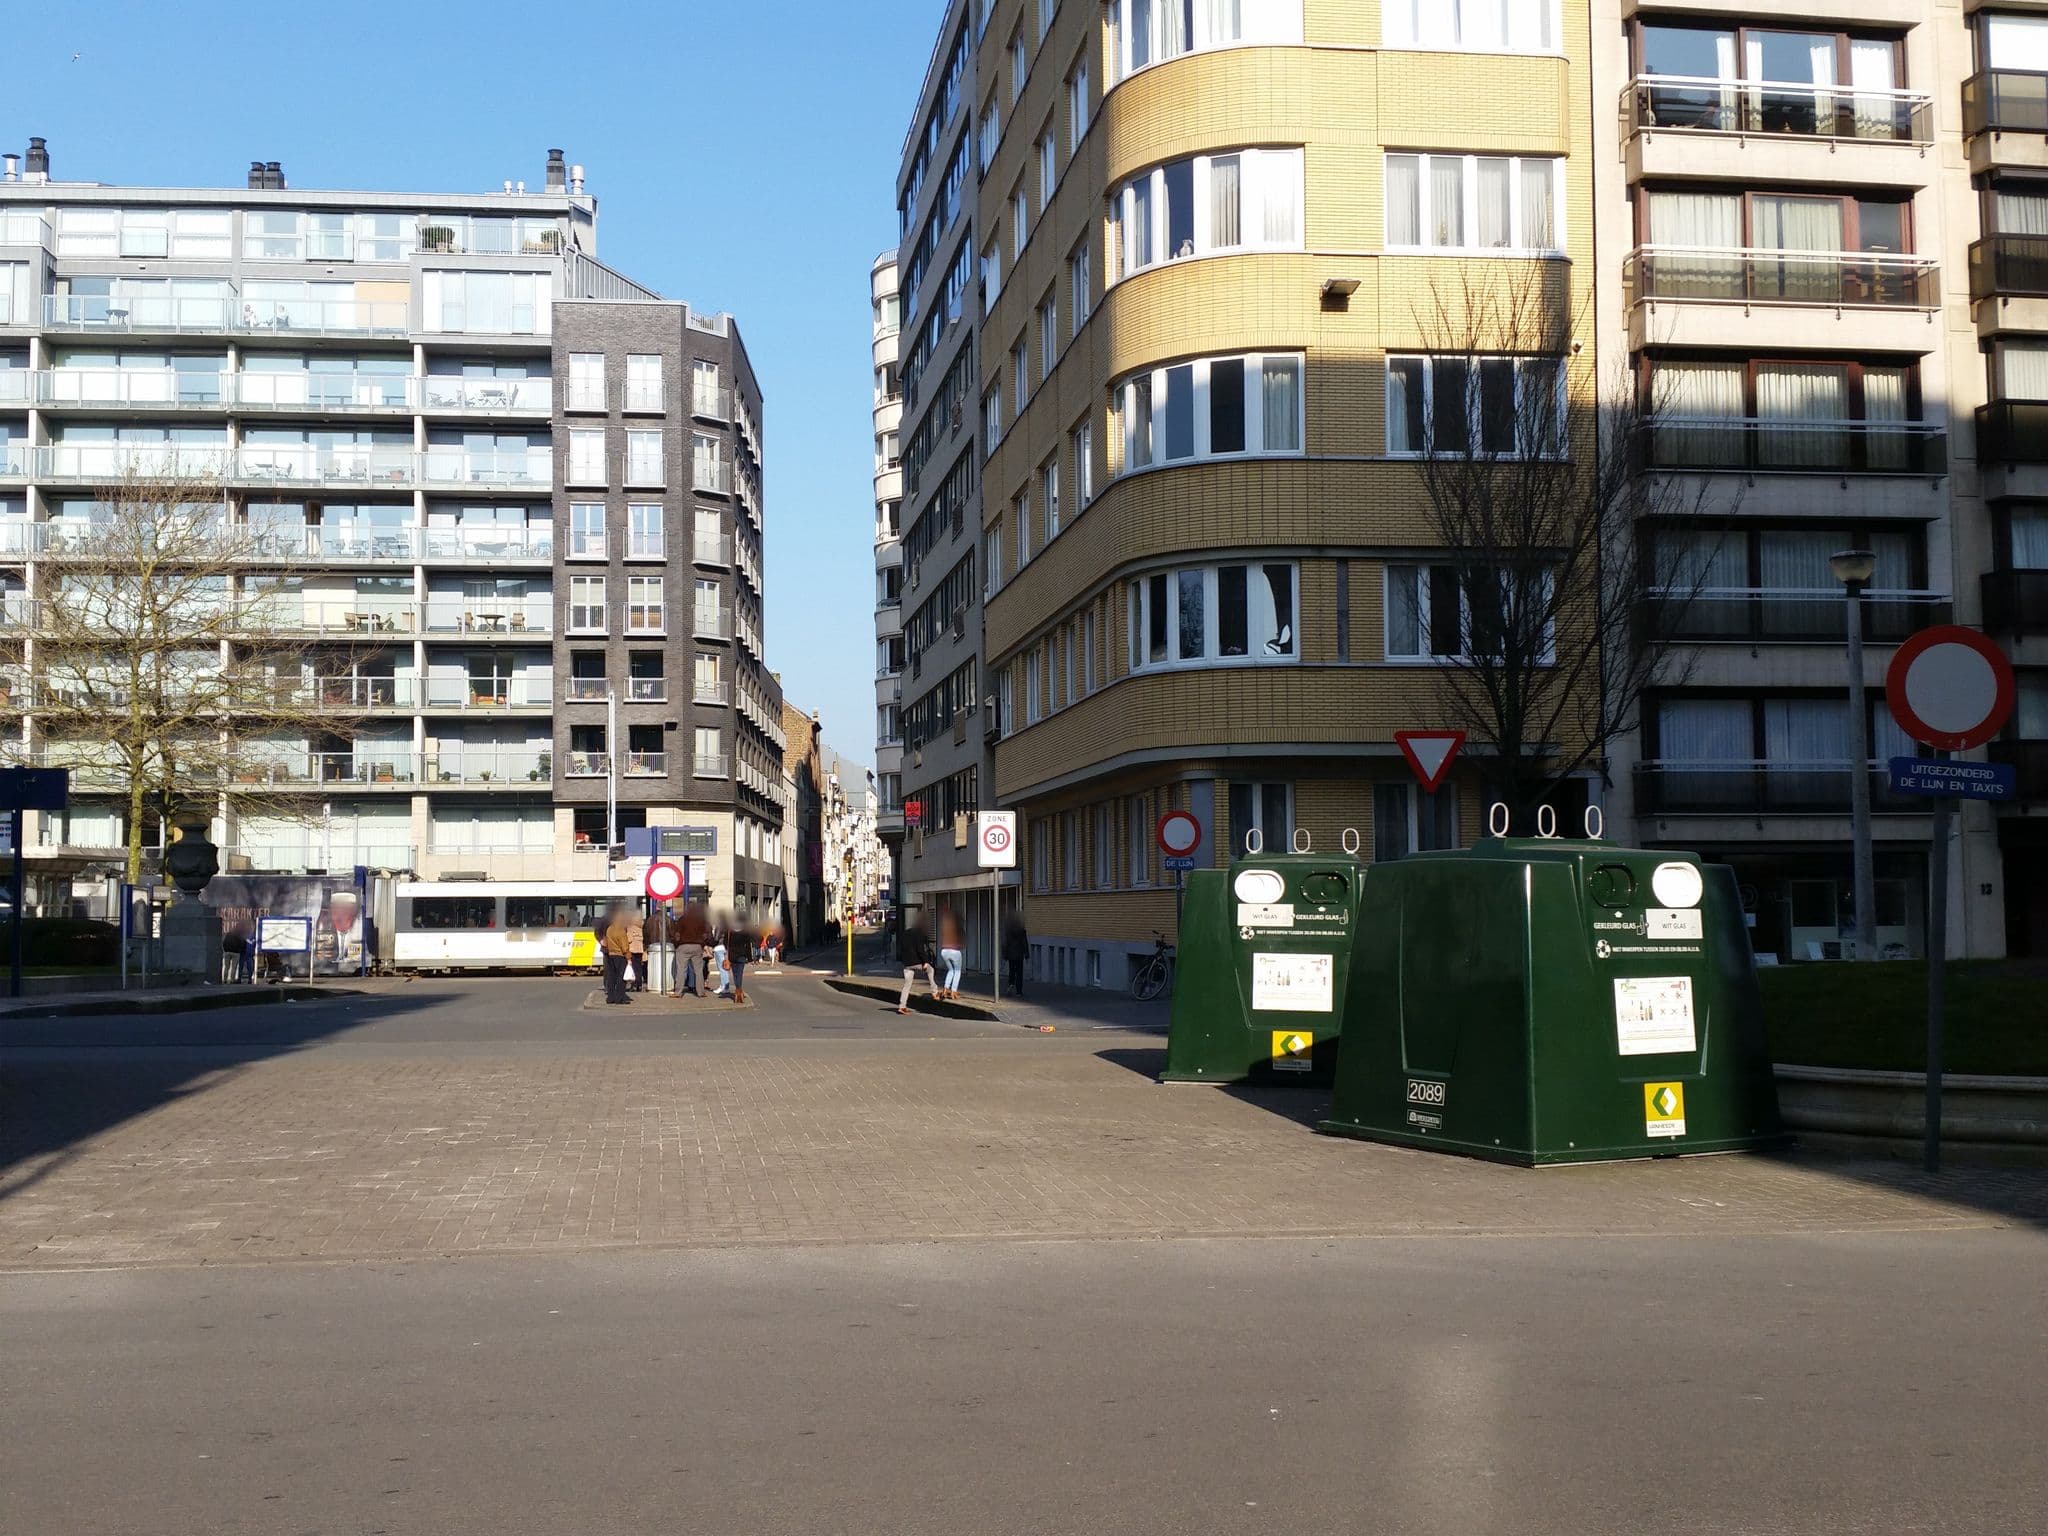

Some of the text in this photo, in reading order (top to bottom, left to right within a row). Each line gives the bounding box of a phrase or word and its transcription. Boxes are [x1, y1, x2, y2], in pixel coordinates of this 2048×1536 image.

[1911, 764, 1994, 780] UITGEZONDERD
[1900, 777, 2004, 794] DE LIJN EN TAXI'S
[989, 833, 1005, 845] 30
[1622, 922, 1637, 930] GLAS
[1674, 922, 1687, 930] GLAS
[1409, 1082, 1443, 1102] 2089
